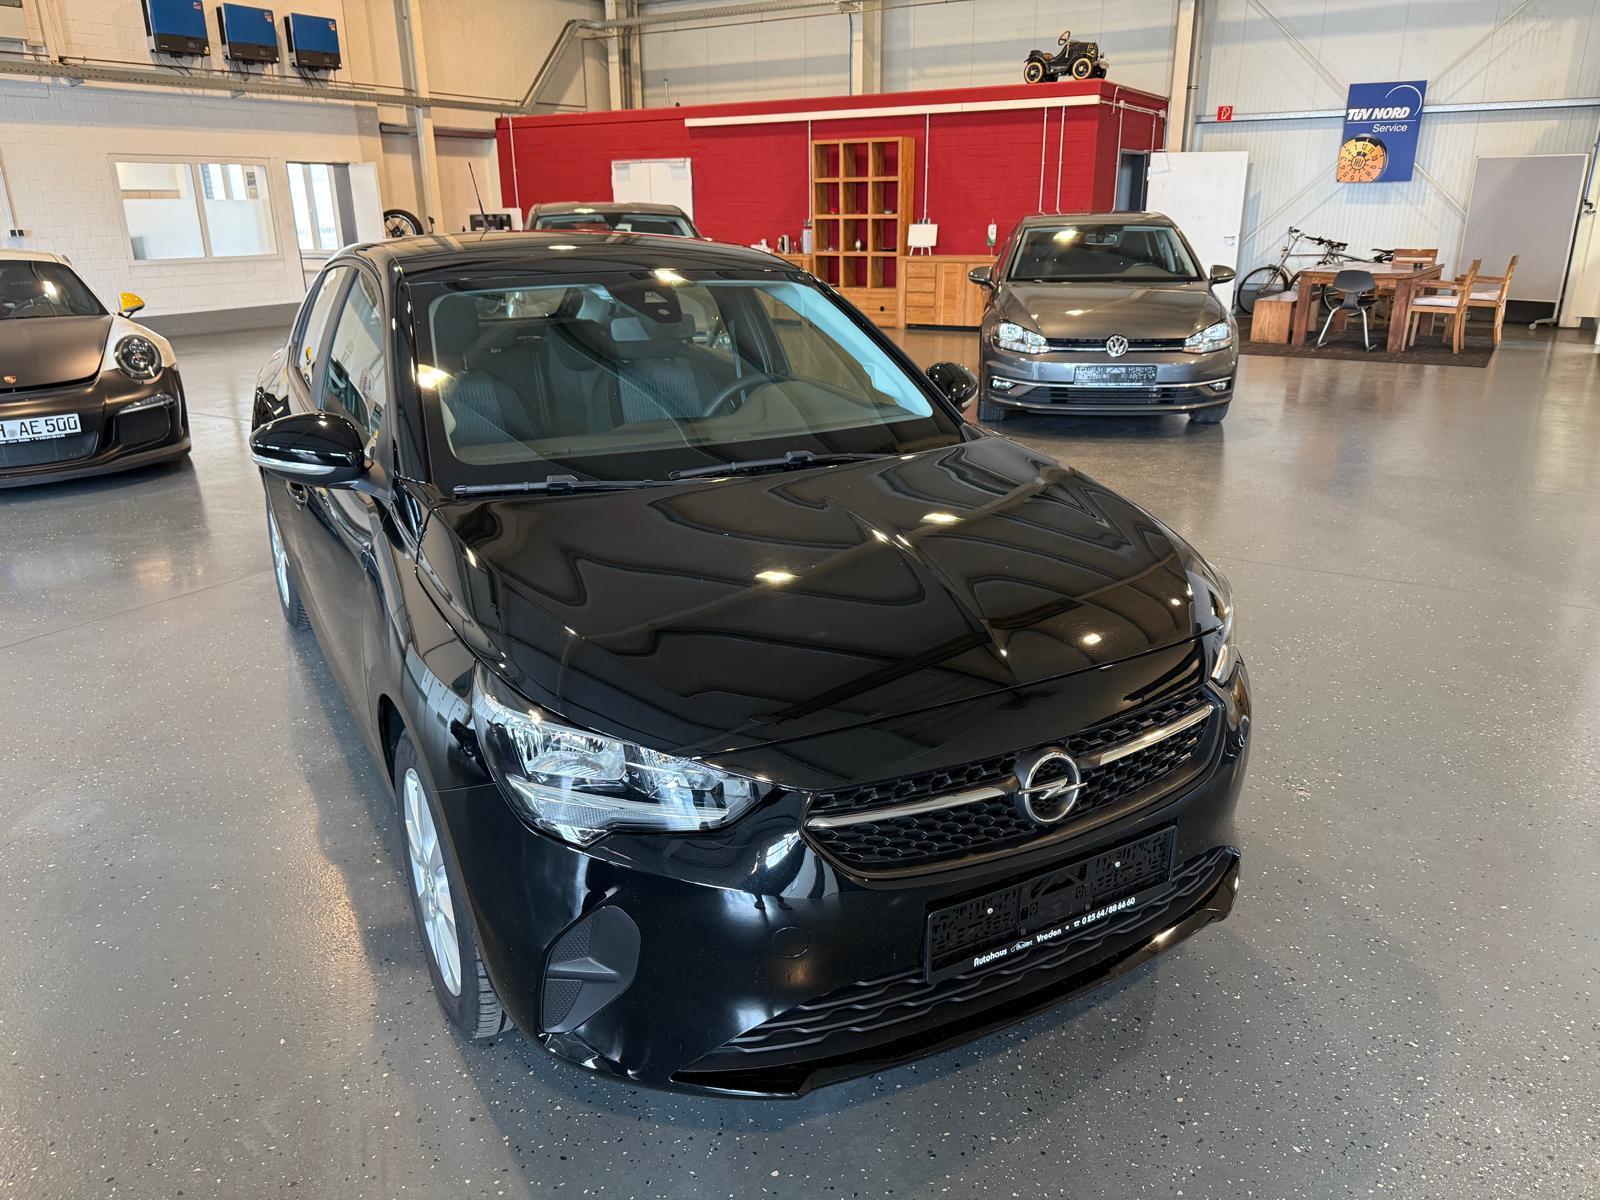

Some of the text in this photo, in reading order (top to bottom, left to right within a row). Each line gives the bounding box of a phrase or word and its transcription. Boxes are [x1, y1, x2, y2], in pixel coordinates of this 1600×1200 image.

[1347, 106, 1411, 121] TÜV NORD
[1373, 123, 1408, 133] Service
[20, 420, 42, 437] AE
[45, 416, 78, 433] 500
[973, 949, 1008, 967] Autohaus
[1036, 928, 1062, 943] Vreden
